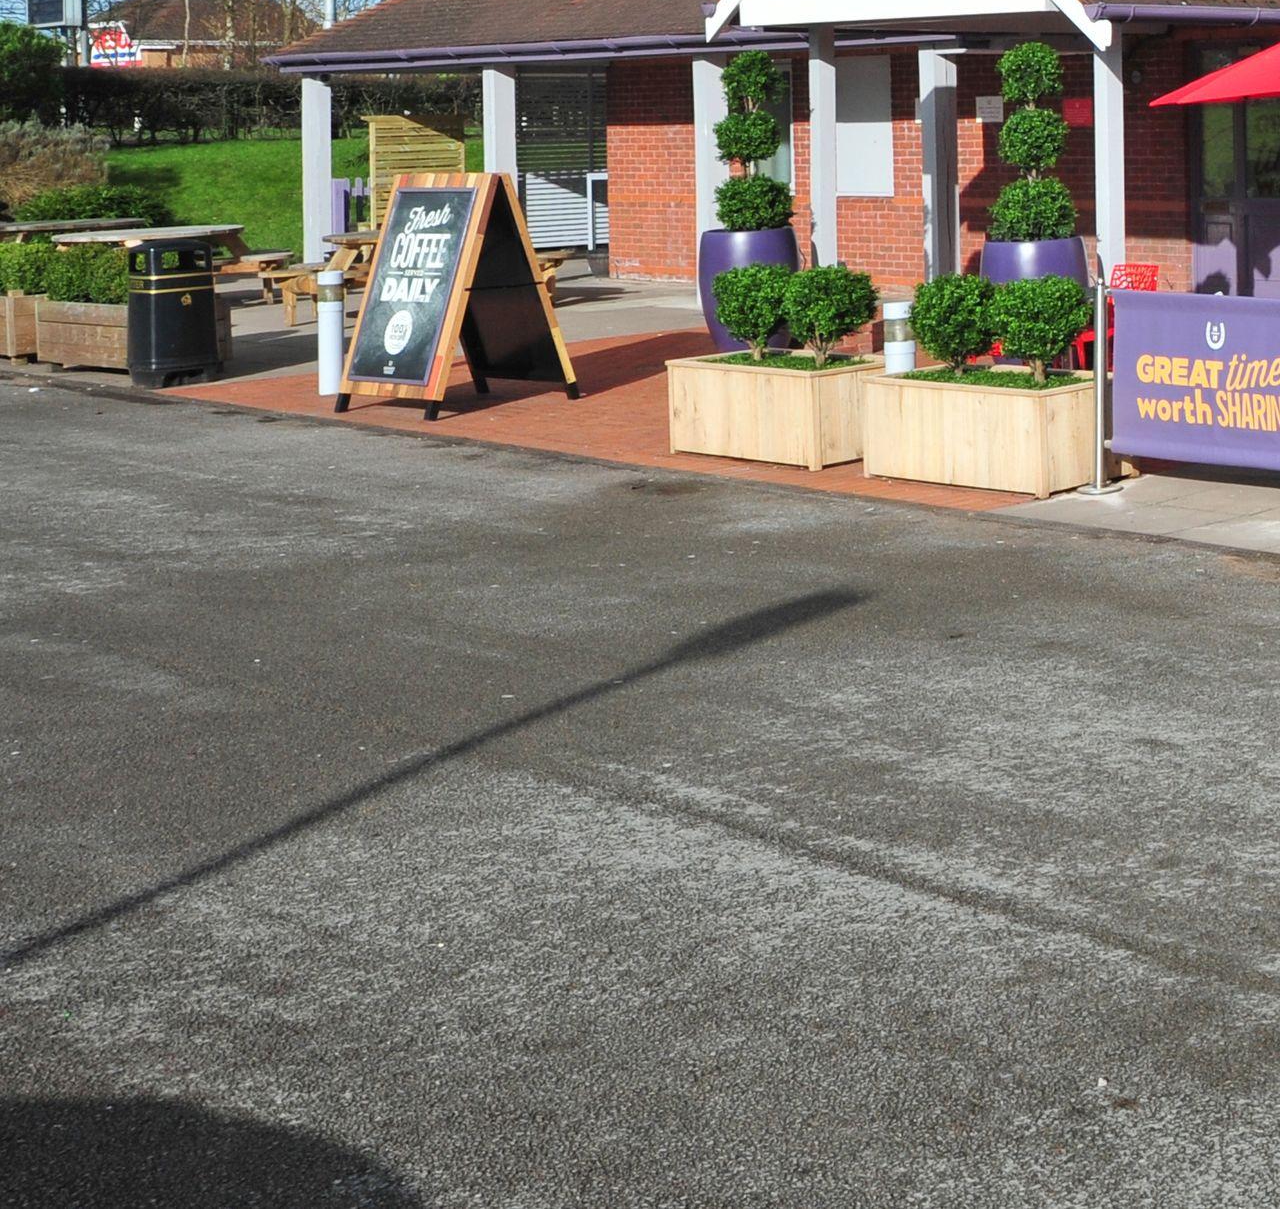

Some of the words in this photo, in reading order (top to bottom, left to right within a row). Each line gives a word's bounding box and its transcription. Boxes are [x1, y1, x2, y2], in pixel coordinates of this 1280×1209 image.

[404, 203, 452, 234] Fresh
[390, 232, 452, 269] COFFEE
[380, 277, 440, 303] DAILY
[1136, 354, 1224, 389] GREAT
[1136, 388, 1213, 425] worth
